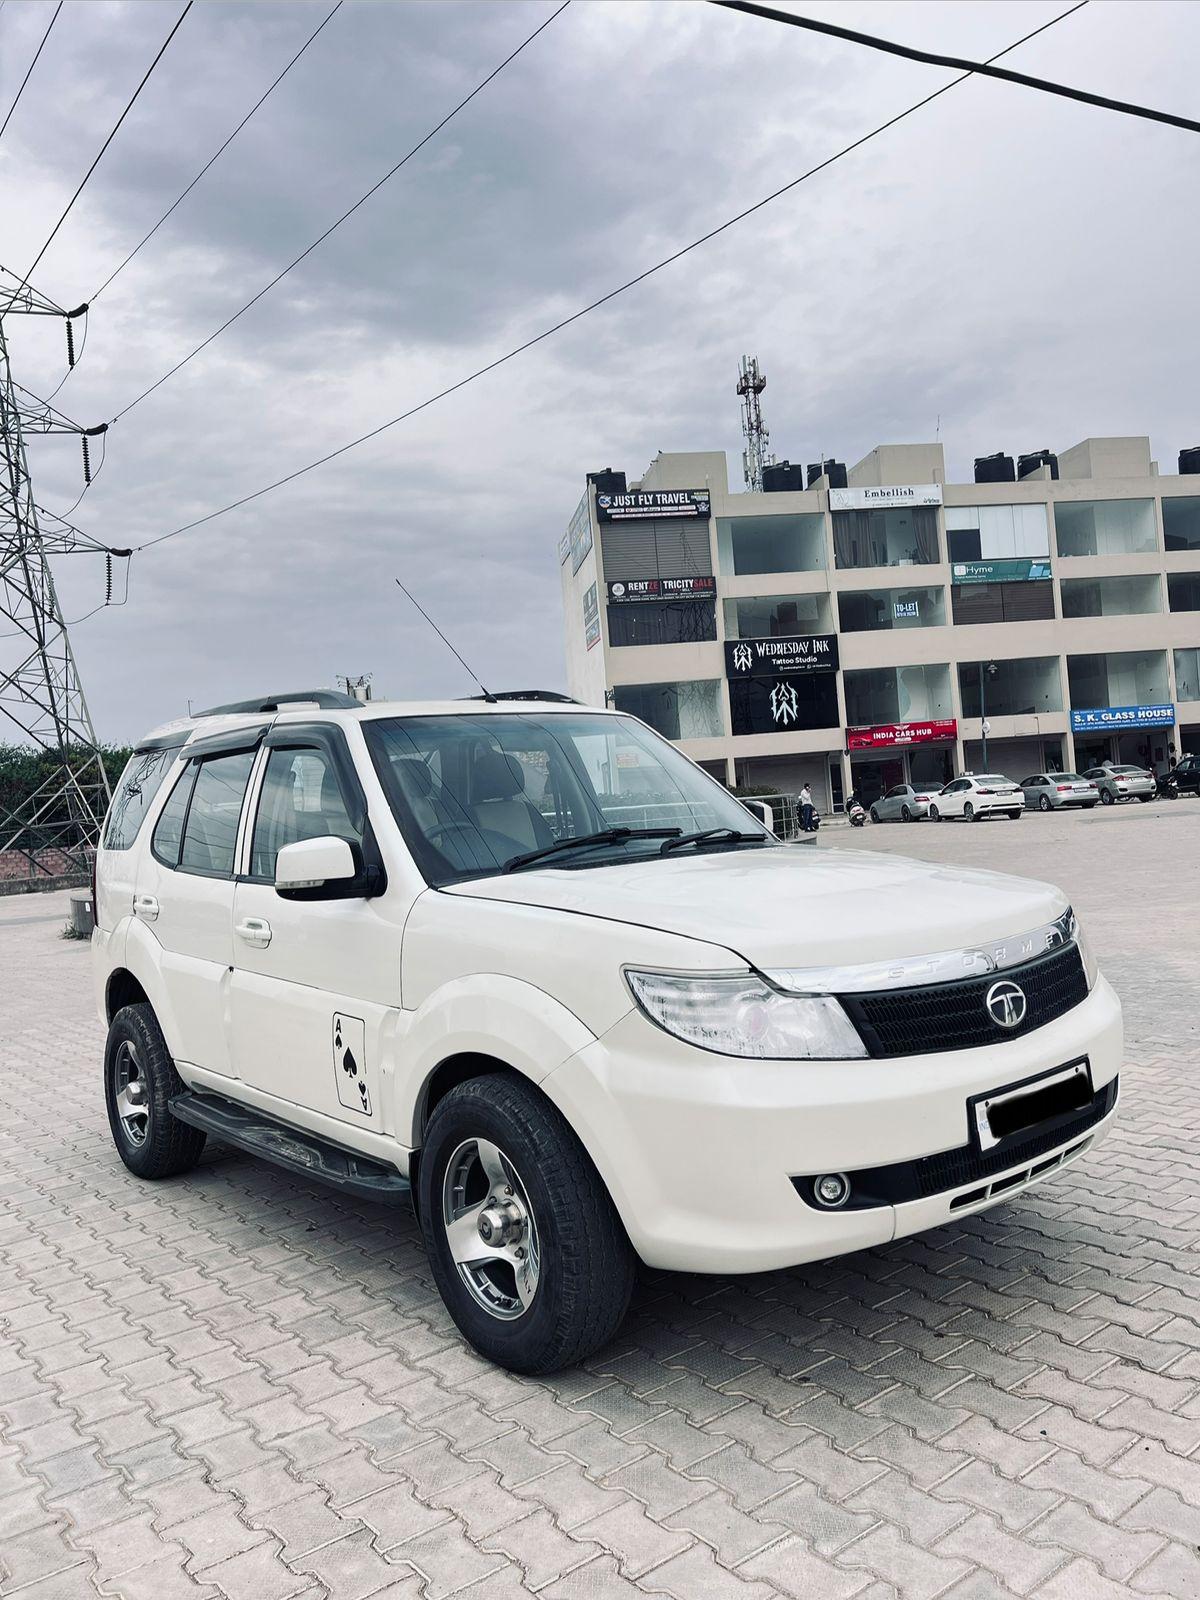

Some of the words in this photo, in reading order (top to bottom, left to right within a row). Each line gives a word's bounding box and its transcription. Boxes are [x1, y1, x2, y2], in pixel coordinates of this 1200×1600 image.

[864, 488, 914, 498] Embellish
[613, 495, 635, 507] JUST
[638, 494, 654, 505] FLY
[656, 492, 690, 505] TRAVEL
[966, 566, 993, 574] Hyme
[896, 603, 915, 612] TO-LET
[795, 655, 818, 664] Studio
[1074, 715, 1084, 723] S.
[1087, 713, 1099, 722] K.
[1101, 711, 1135, 721] GLASS
[1138, 708, 1174, 718] HOUSE
[916, 728, 932, 736] HUB
[888, 931, 1054, 979] STORME
[335, 1018, 342, 1033] A
